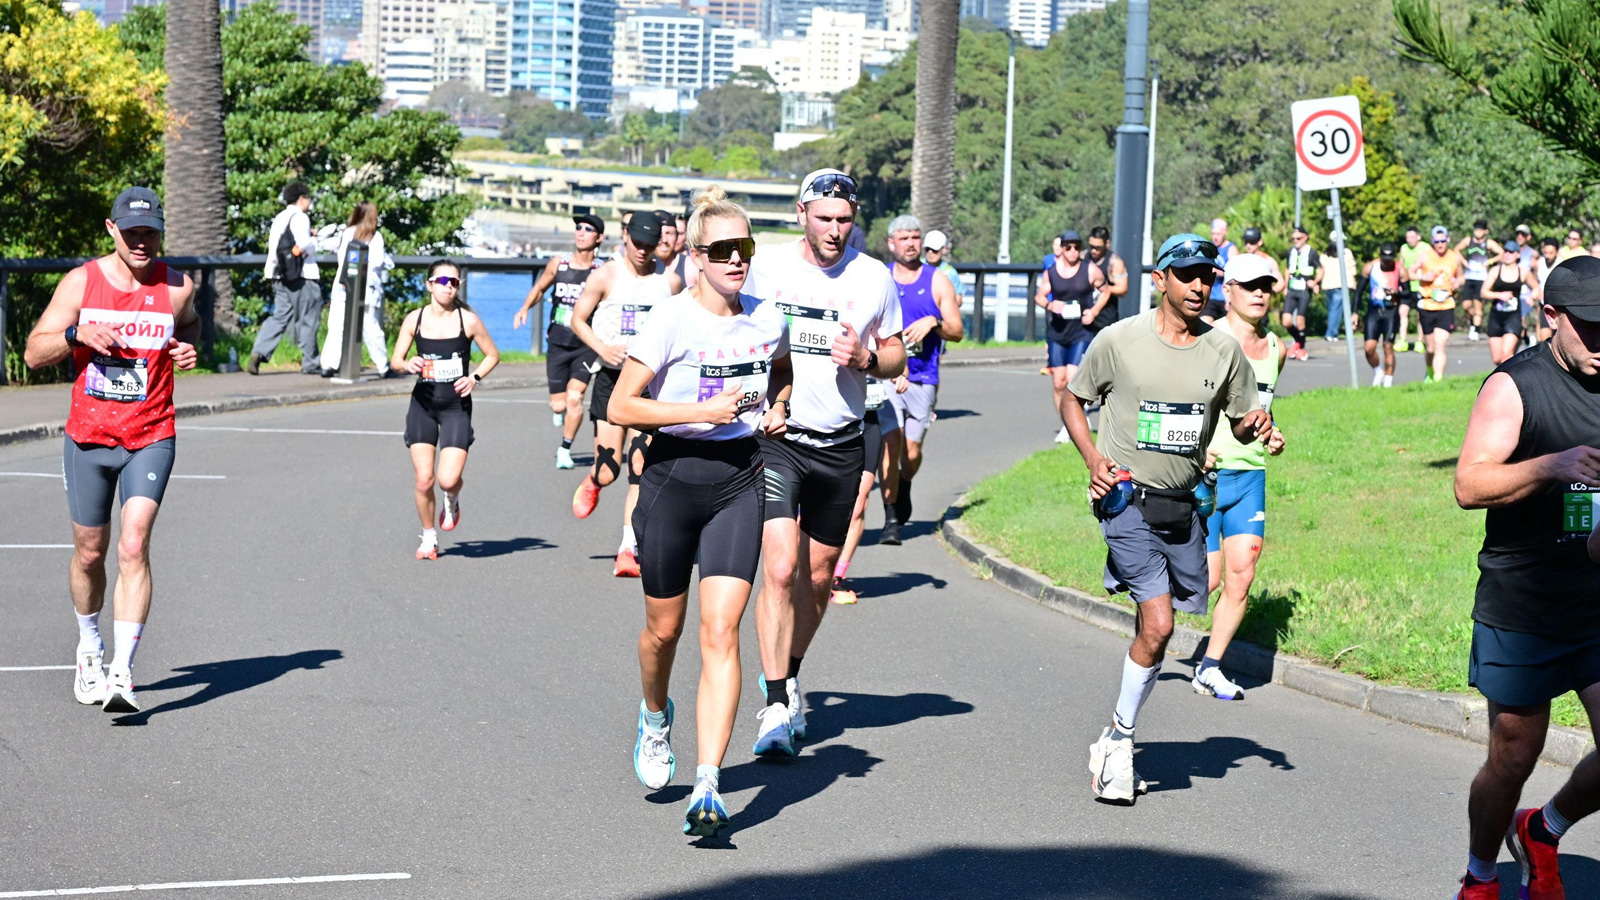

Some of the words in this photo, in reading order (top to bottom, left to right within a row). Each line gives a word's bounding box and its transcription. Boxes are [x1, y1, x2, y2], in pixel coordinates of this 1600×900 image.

[1311, 128, 1350, 157] 30
[776, 291, 855, 310] FALKE
[88, 320, 165, 338] ОЙЛ
[799, 332, 827, 345] 8156
[698, 344, 770, 361] FALKE
[705, 366, 721, 376] tcs
[111, 380, 140, 392] 5563
[740, 391, 759, 405] 58
[1141, 429, 1146, 439] 1
[1167, 430, 1197, 442] 8266
[1569, 515, 1574, 527] 1
[1582, 515, 1590, 527] E
